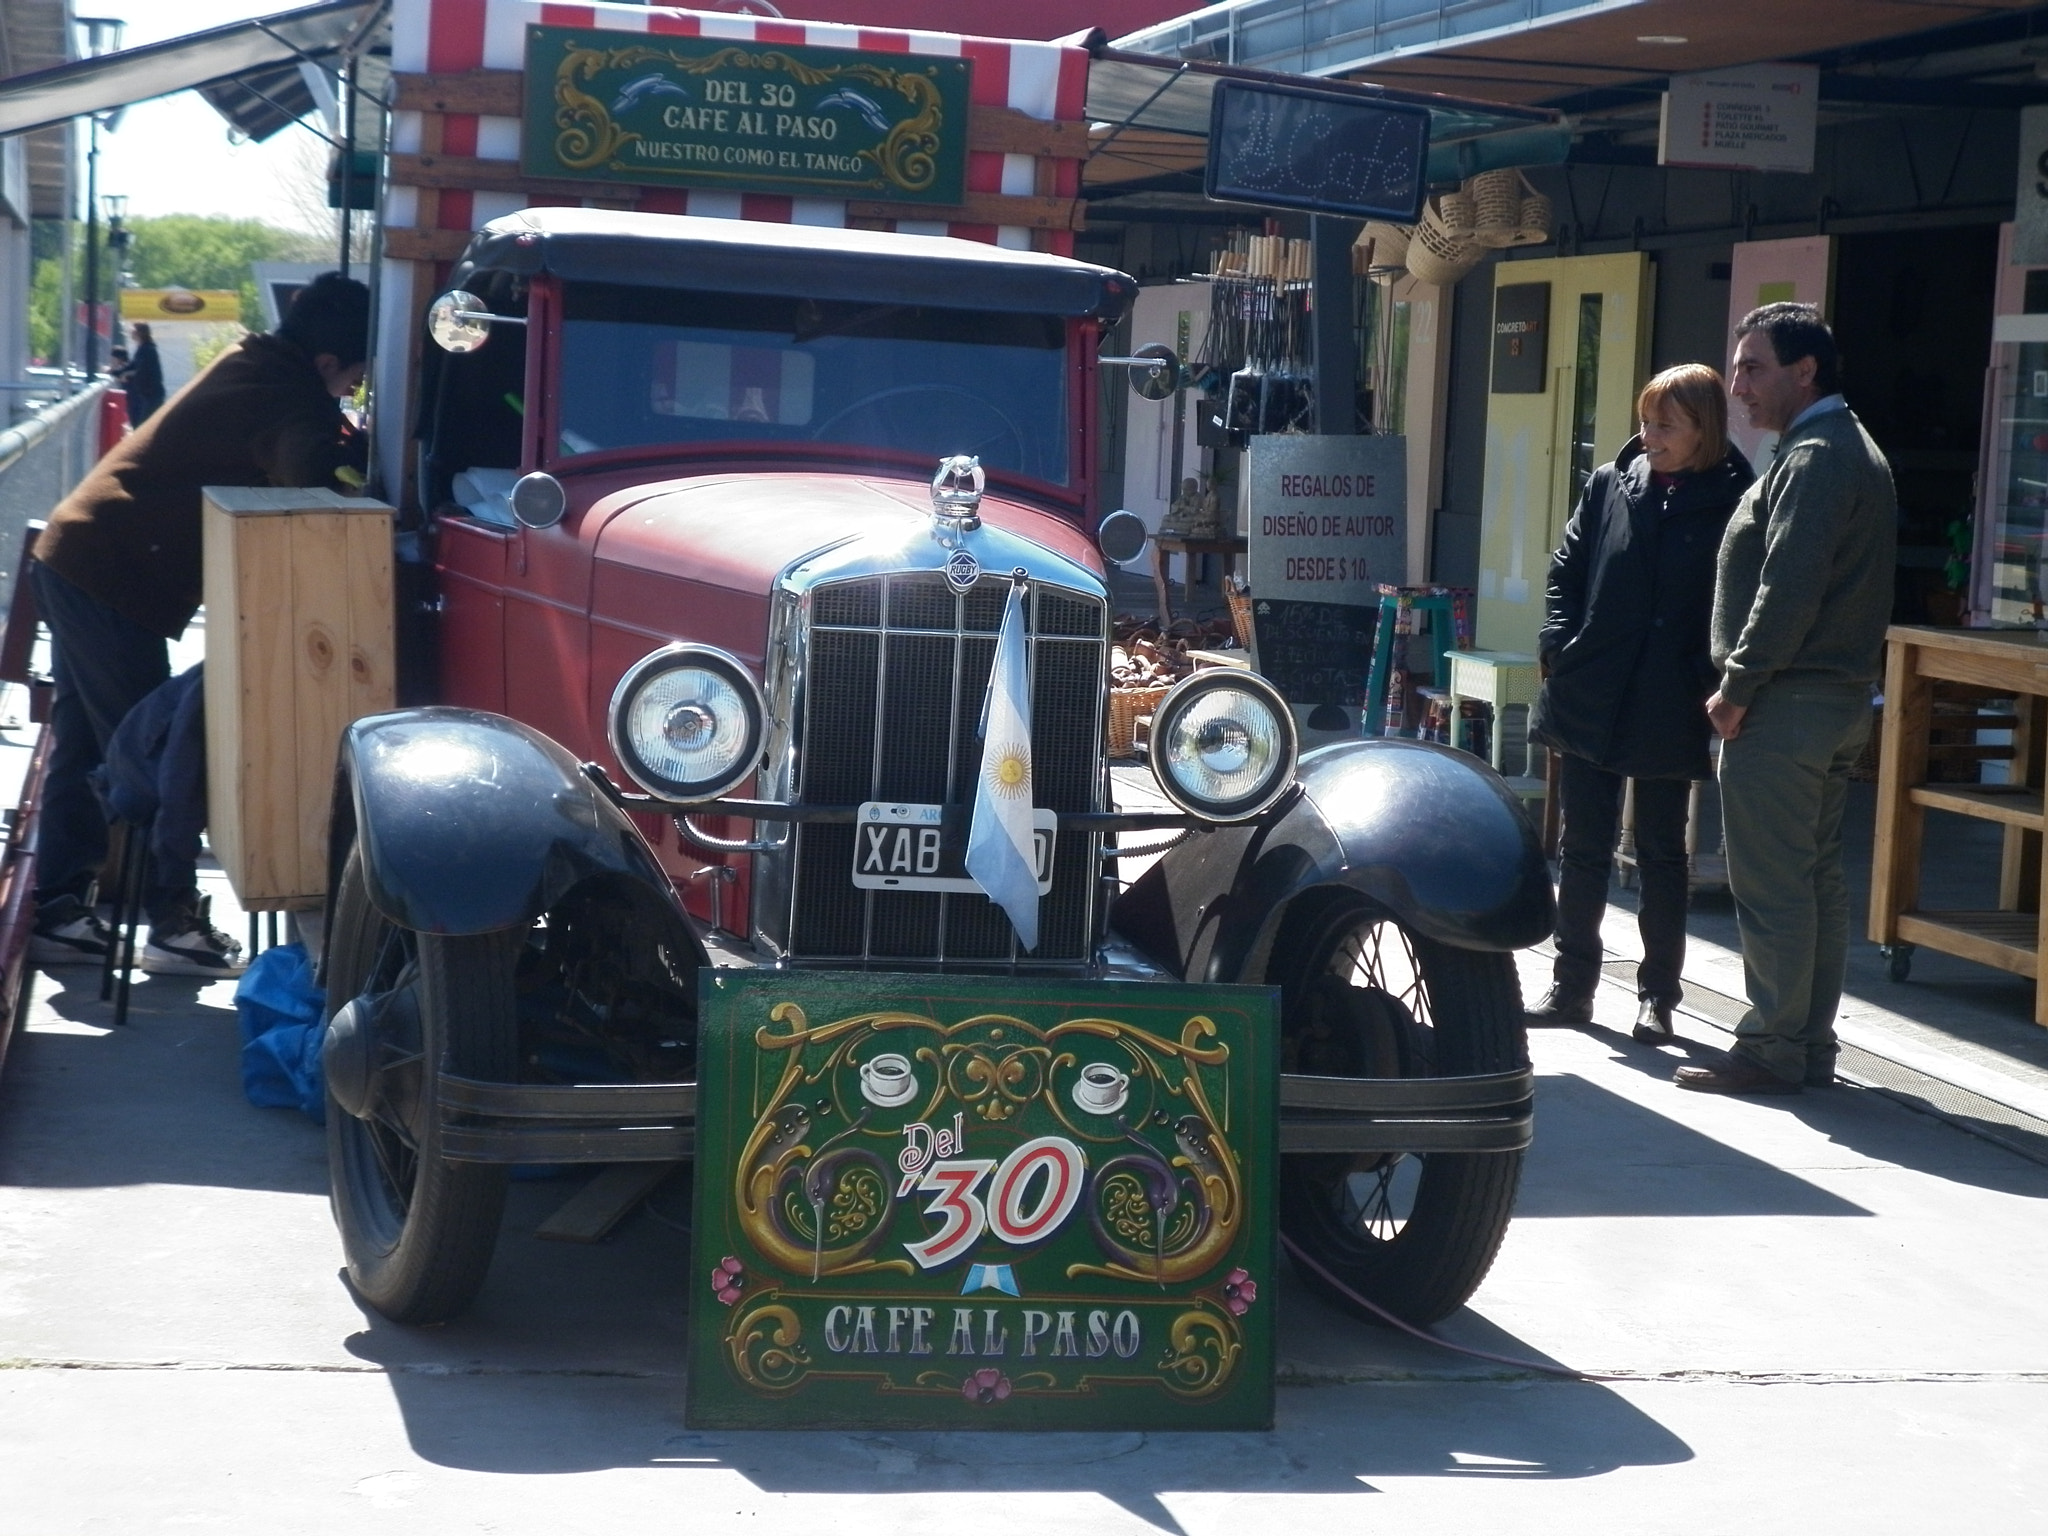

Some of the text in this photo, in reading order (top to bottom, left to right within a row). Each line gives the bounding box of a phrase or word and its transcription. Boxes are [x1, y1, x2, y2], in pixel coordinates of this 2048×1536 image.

[705, 79, 796, 108] DEL 30
[1716, 102, 1762, 113] CORREDOR
[1716, 112, 1752, 122] TOILETTE
[664, 106, 838, 141] CAFE AL PASO
[1715, 121, 1780, 132] PATIO GOURMET
[1714, 131, 1788, 142] PLAZA MERCADOS
[1714, 140, 1746, 149] MUELLE
[635, 140, 863, 173] NUESTRO COMO EL TANGO
[1281, 475, 1376, 497] REGALOS DE
[1263, 511, 1395, 536] DISEÑO DE AUTOR
[950, 564, 977, 575] RUGBY
[1286, 557, 1335, 581] DESDE
[863, 825, 941, 874] XAB
[898, 1112, 964, 1174] Del
[824, 1305, 1141, 1359] CAFE AL PASO
